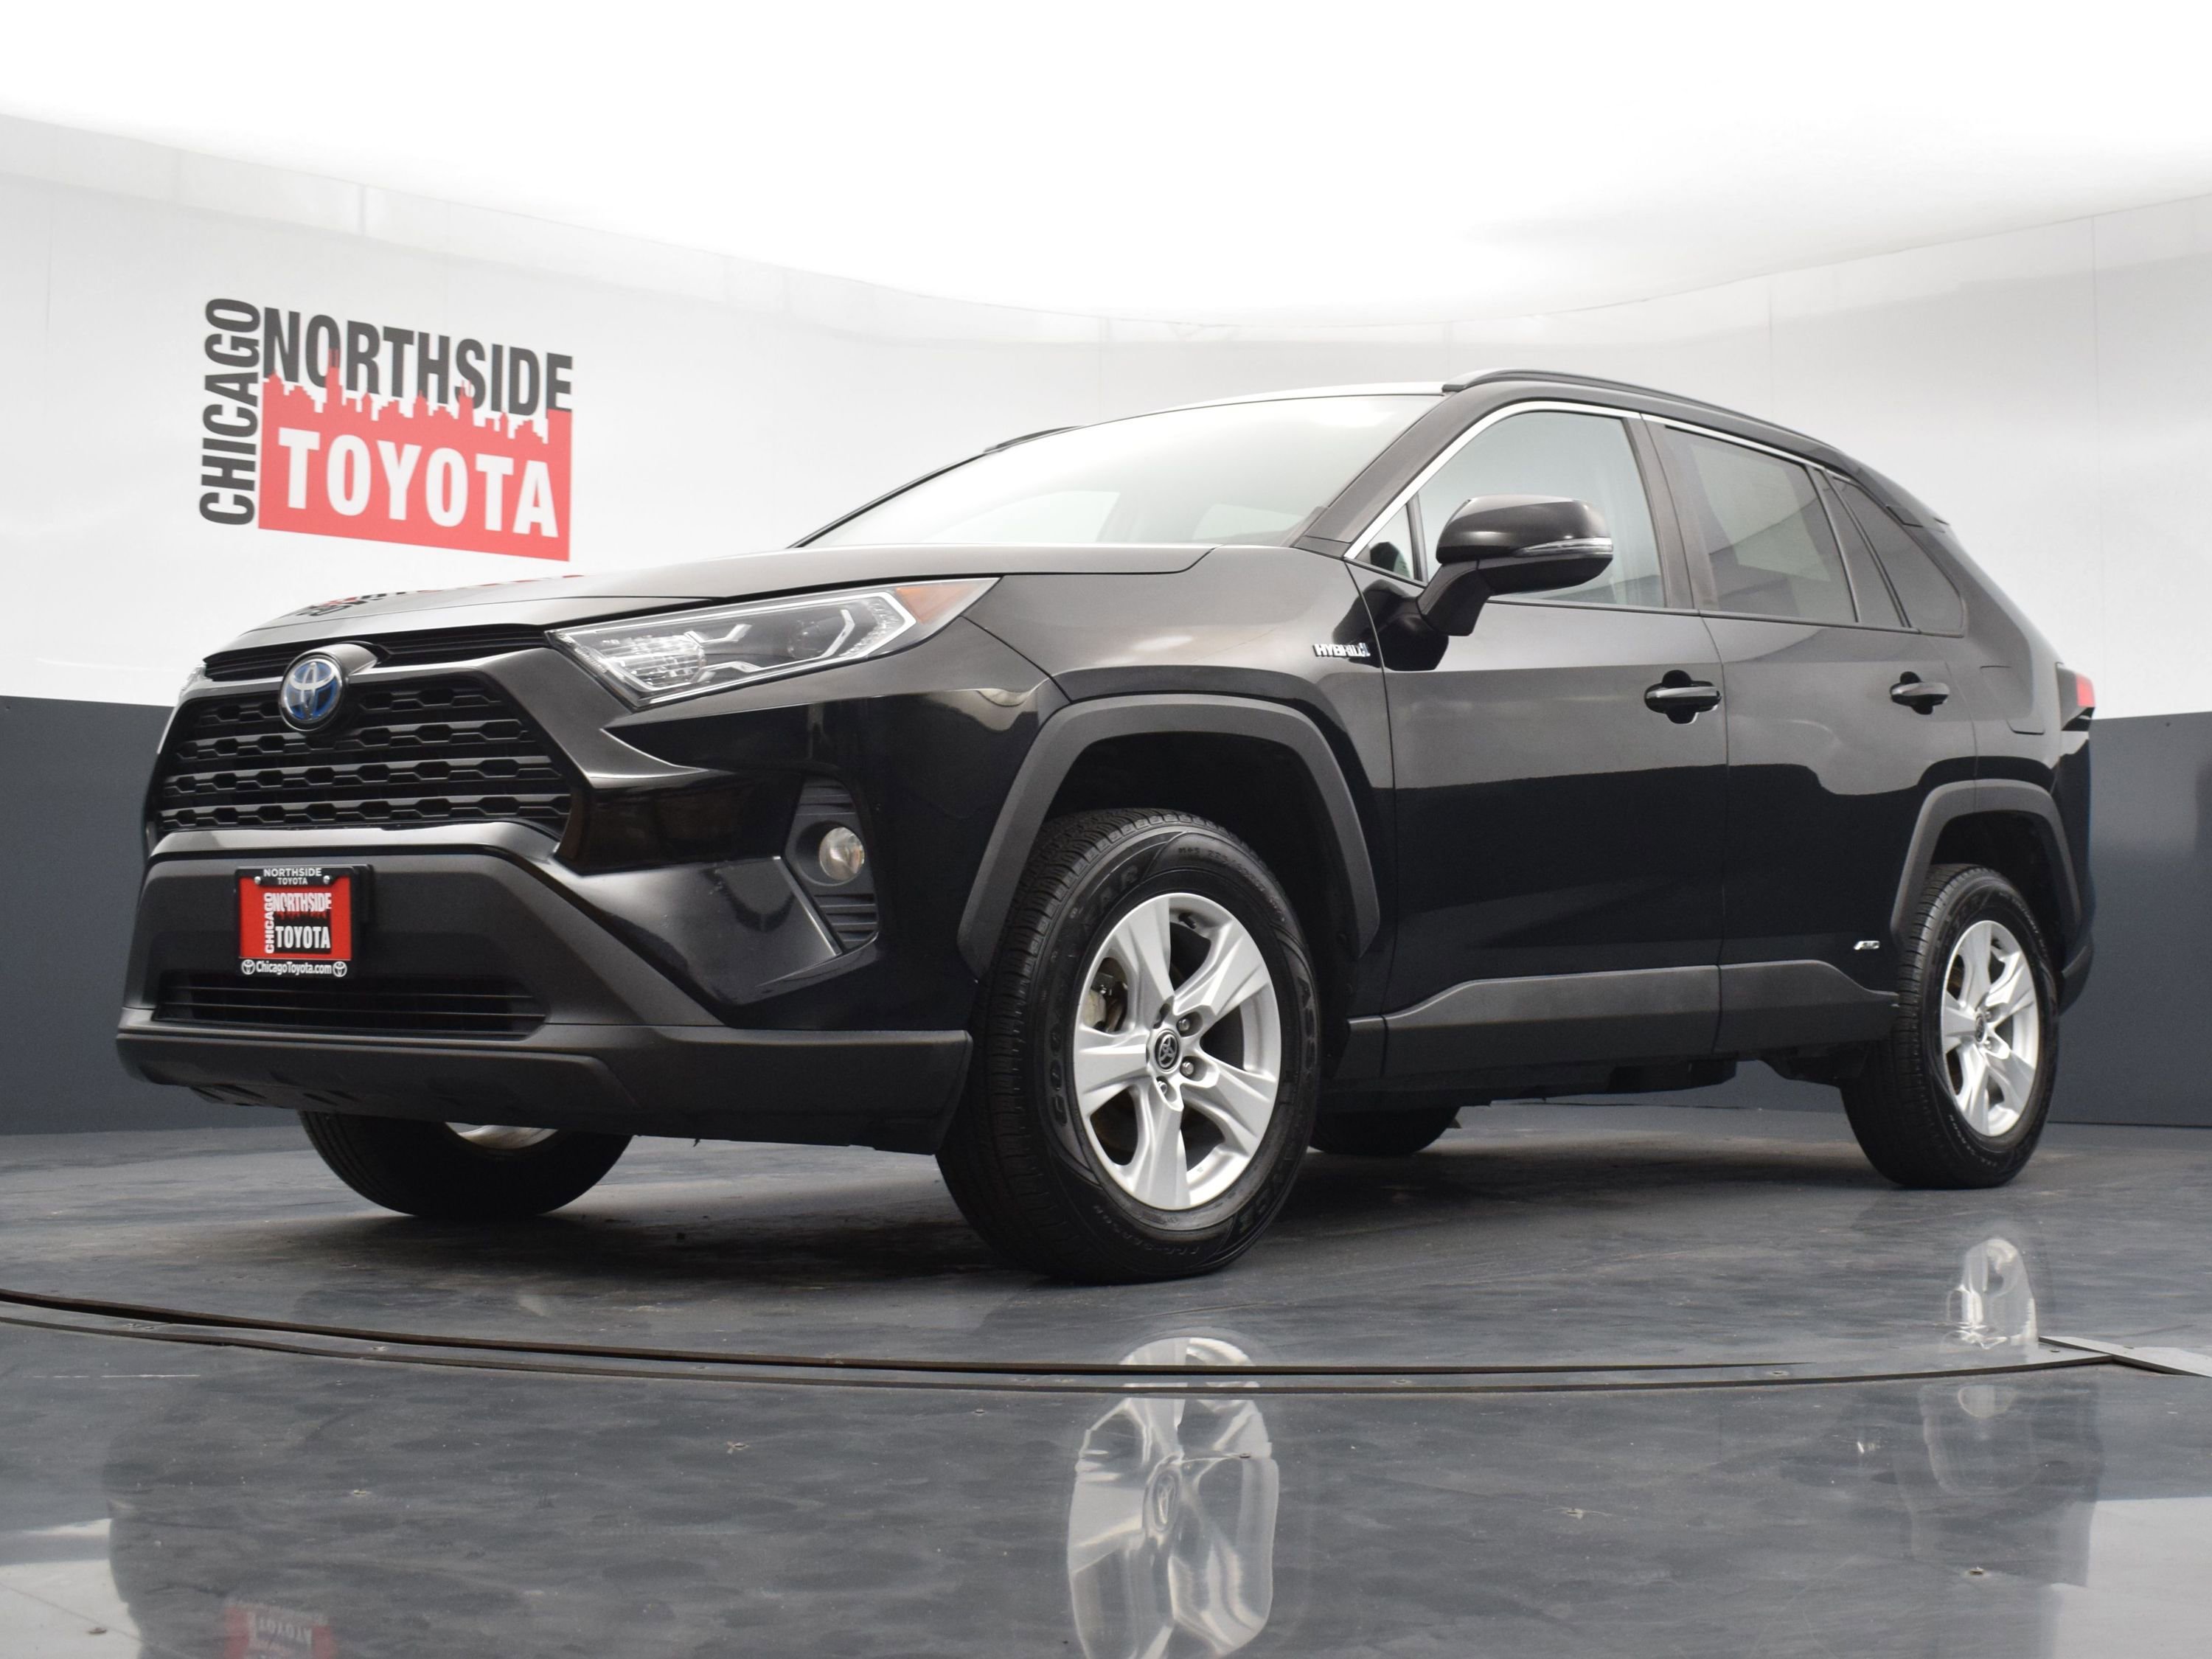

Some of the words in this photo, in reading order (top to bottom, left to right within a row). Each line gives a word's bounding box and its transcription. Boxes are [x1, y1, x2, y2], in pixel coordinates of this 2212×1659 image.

[262, 307, 573, 417] NORTHSIDE
[199, 298, 261, 526] CHICAGO
[278, 426, 559, 538] TOYOTA
[263, 868, 322, 877] NORTHSIDE
[278, 877, 308, 885] TOYOTA
[272, 893, 333, 912] NORTHSIDE
[263, 892, 275, 953] CHICAGO
[275, 925, 331, 949] TOYOTA
[256, 960, 332, 975] ChicagoToyota.com
